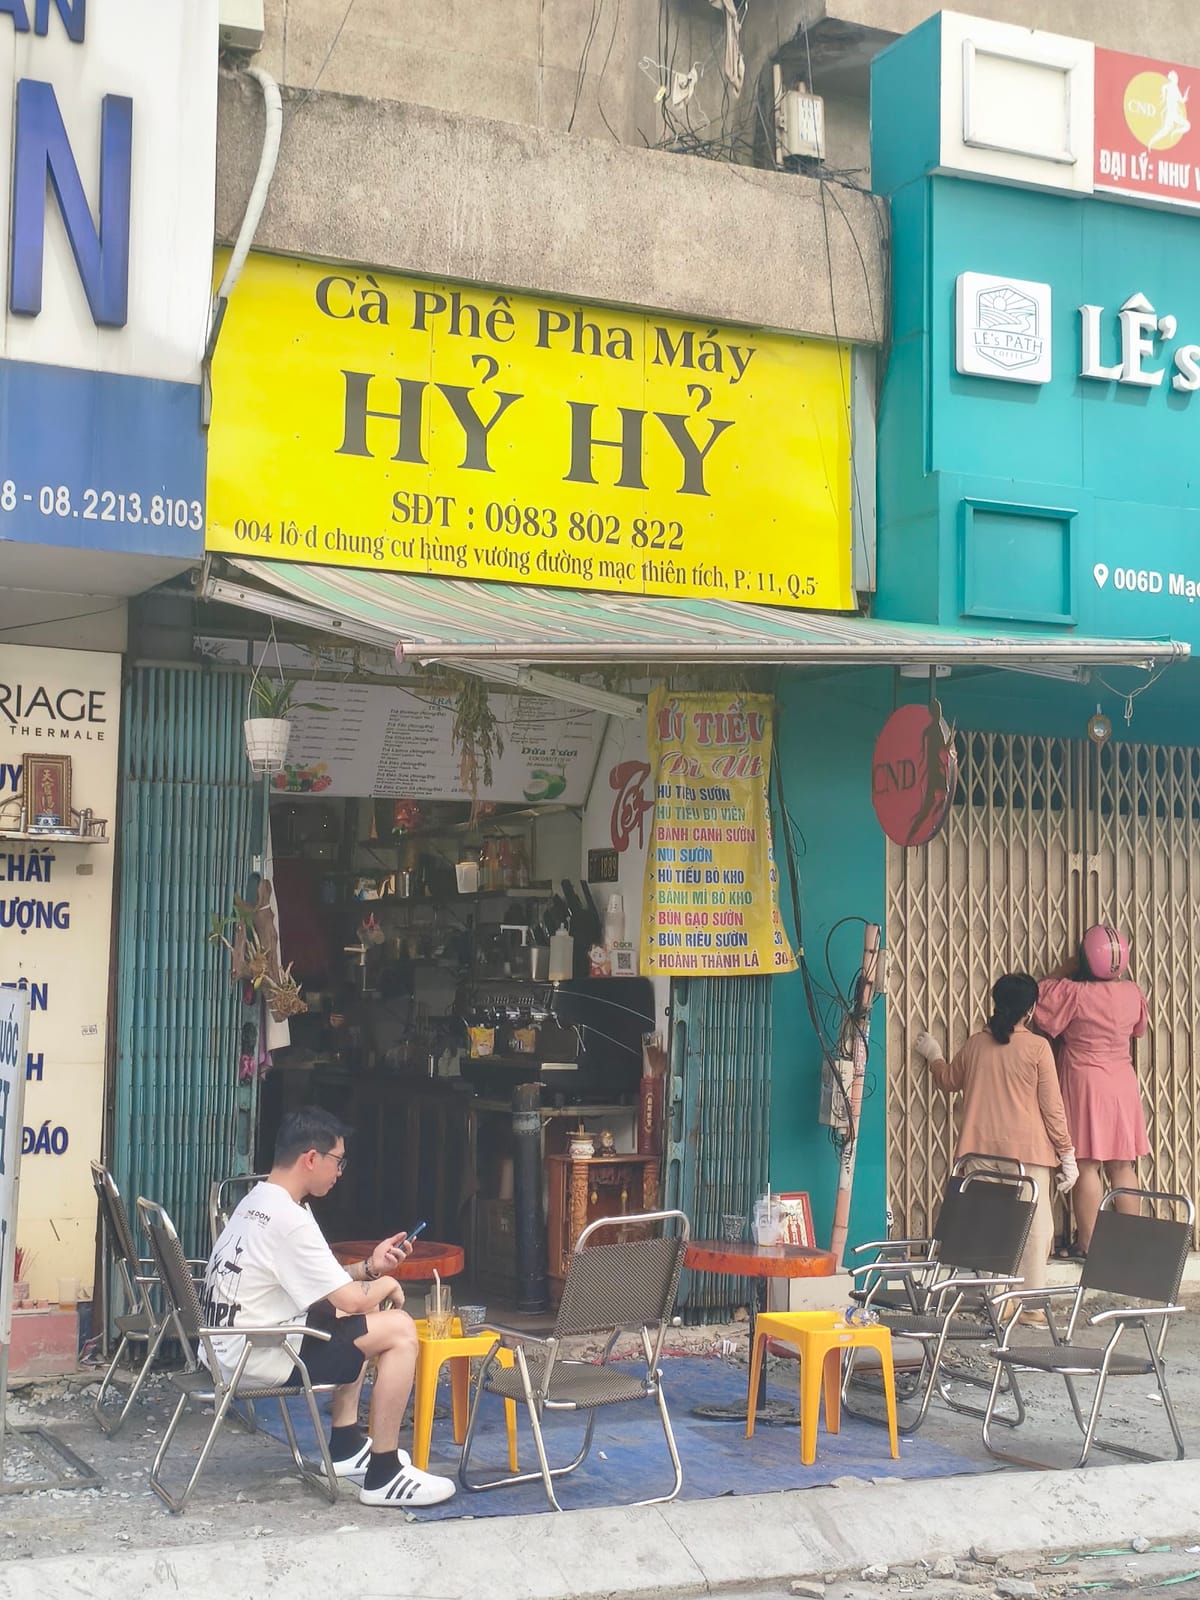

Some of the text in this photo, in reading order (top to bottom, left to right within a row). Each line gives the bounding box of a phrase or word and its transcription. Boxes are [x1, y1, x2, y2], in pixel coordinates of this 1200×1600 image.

[1128, 98, 1156, 117] CND
[1100, 149, 1126, 181] ĐẠI
[1131, 151, 1154, 181] LÝ:
[1158, 160, 1191, 189] NHƯ
[315, 274, 757, 384] Cà Phê Pha Máy
[1006, 334, 1043, 354] PATH
[334, 353, 736, 497] HỶ HỶ
[39, 485, 204, 531] 08.2213.8103
[391, 491, 457, 527] SĐT
[485, 502, 558, 539] 0983
[568, 512, 621, 545] 802
[631, 518, 684, 551] 822
[234, 519, 272, 543] 004
[280, 521, 299, 546] lô
[305, 525, 317, 548] d
[325, 528, 385, 560] chung
[391, 538, 415, 558] cư
[420, 536, 467, 568] hùng
[474, 546, 530, 575] vương
[536, 549, 593, 581] đường
[599, 560, 636, 584] mạc
[641, 559, 686, 585] thiên
[692, 563, 729, 590] tích,
[1114, 567, 1162, 593] 006D
[10, 725, 105, 741] THERMALE
[872, 759, 917, 794] CND
[693, 827, 722, 842] CANH
[657, 847, 675, 861] NUI
[675, 866, 701, 884] TIẾU
[705, 867, 720, 884] BÒ
[723, 870, 745, 884] KHO
[729, 891, 753, 905] KHO
[684, 912, 709, 929] GẠO
[659, 930, 682, 947] BÚN
